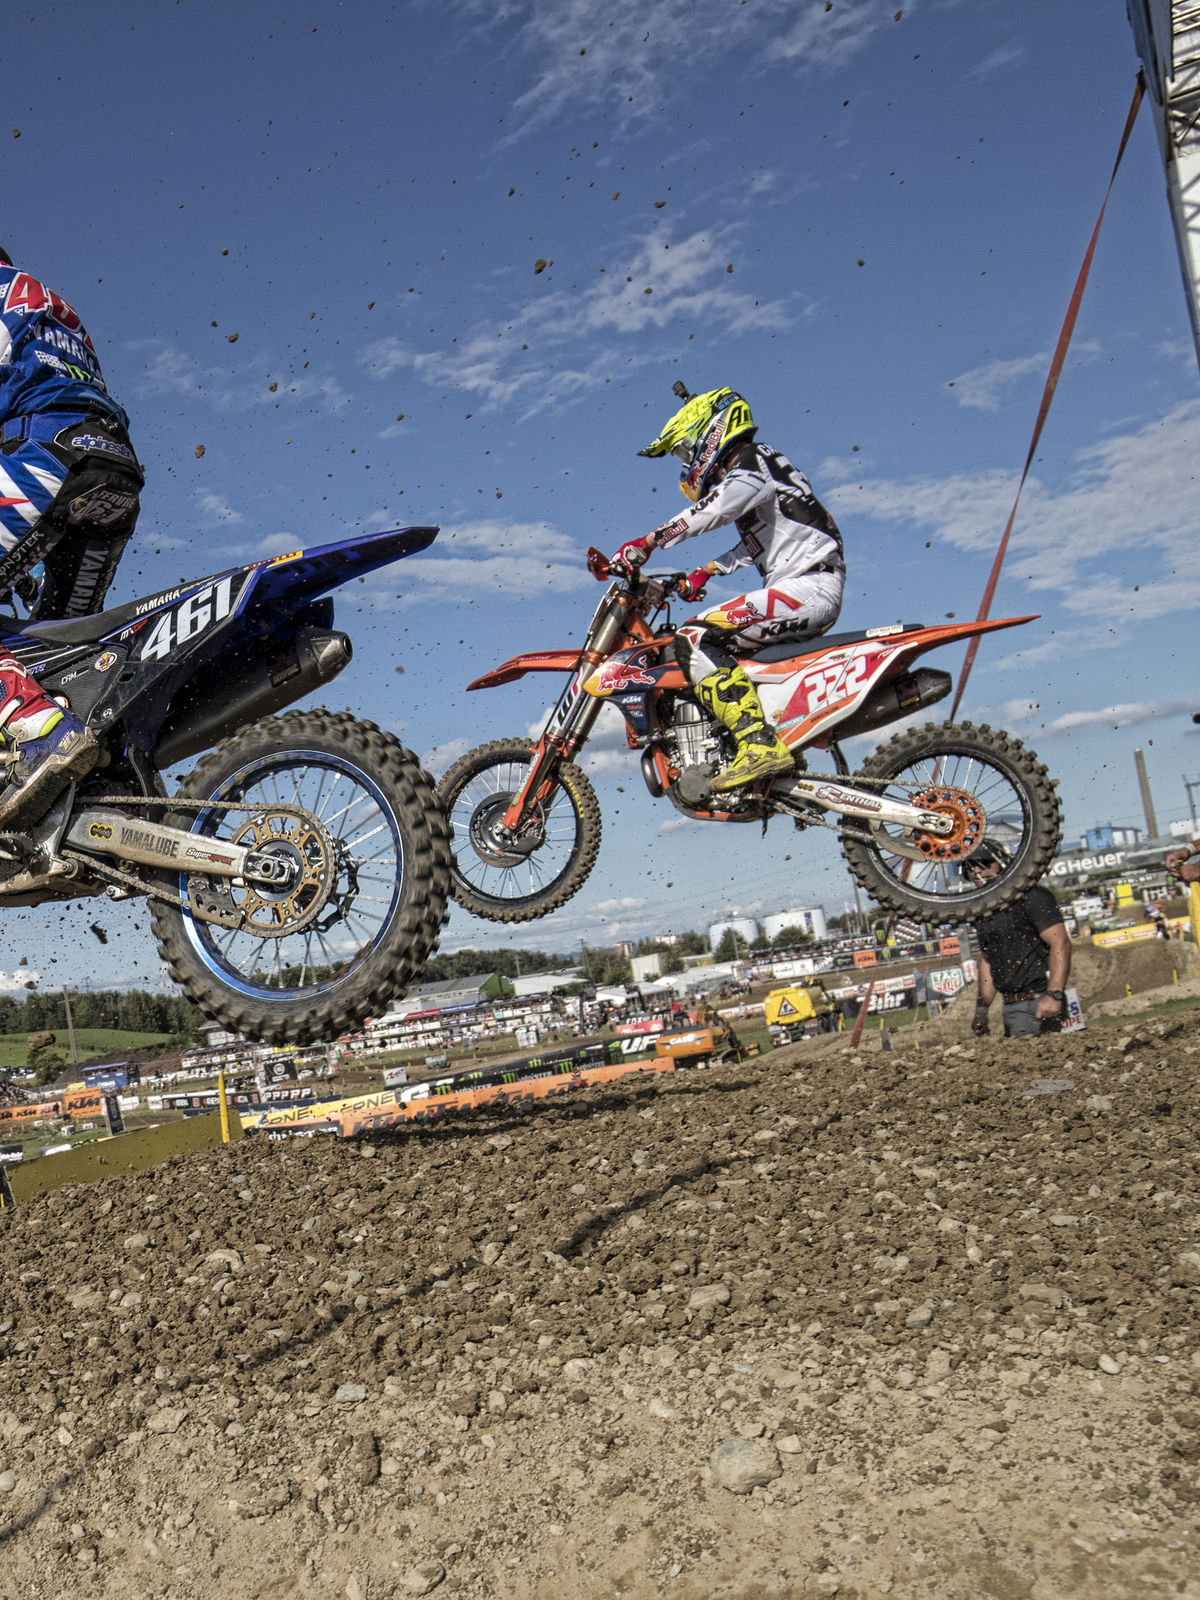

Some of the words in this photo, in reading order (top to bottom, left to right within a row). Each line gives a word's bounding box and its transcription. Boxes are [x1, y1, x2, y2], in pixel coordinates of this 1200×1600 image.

[710, 418, 727, 443] Bull
[135, 590, 181, 616] YAMAHA
[140, 575, 233, 662] 461
[760, 616, 810, 640] KTM
[803, 655, 868, 713] 222
[563, 775, 585, 819] PIRELLI
[120, 827, 180, 858] YAMALUBE
[934, 971, 960, 982] TAG
[67, 1094, 100, 1111] KTM
